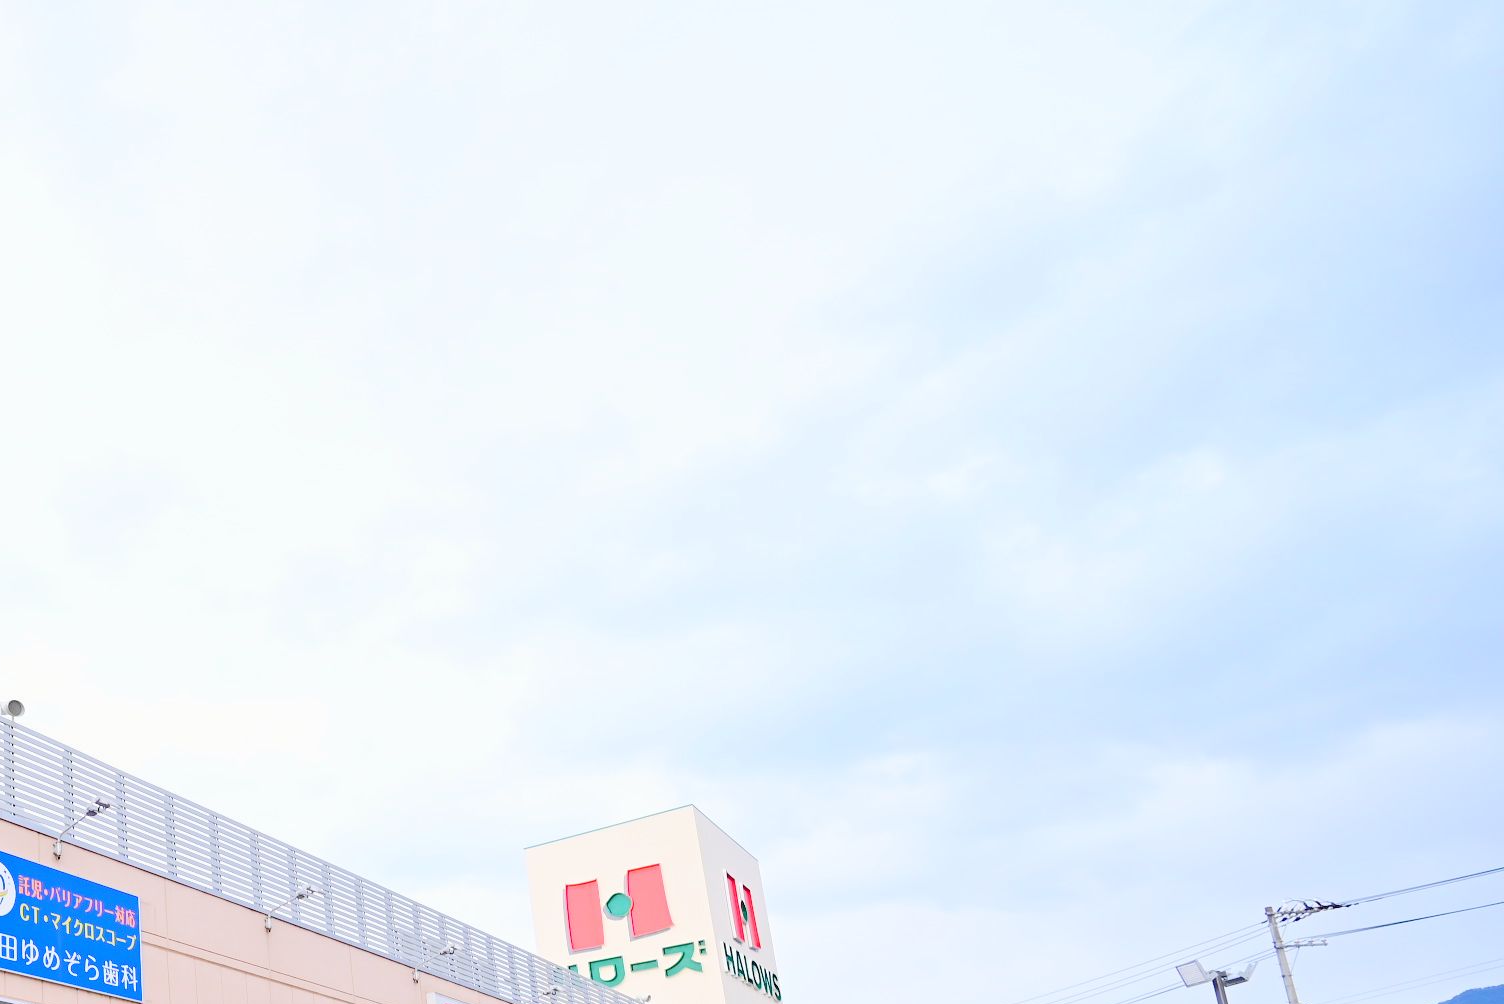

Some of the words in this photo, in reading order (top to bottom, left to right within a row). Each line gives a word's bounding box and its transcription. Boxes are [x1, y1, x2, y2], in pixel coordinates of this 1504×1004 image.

[18, 874, 136, 929] 託児・バリアフリー対応
[19, 903, 136, 951] CT・マイクロスコープ
[568, 939, 707, 988] ローズ
[722, 942, 782, 1001] HALOWS
